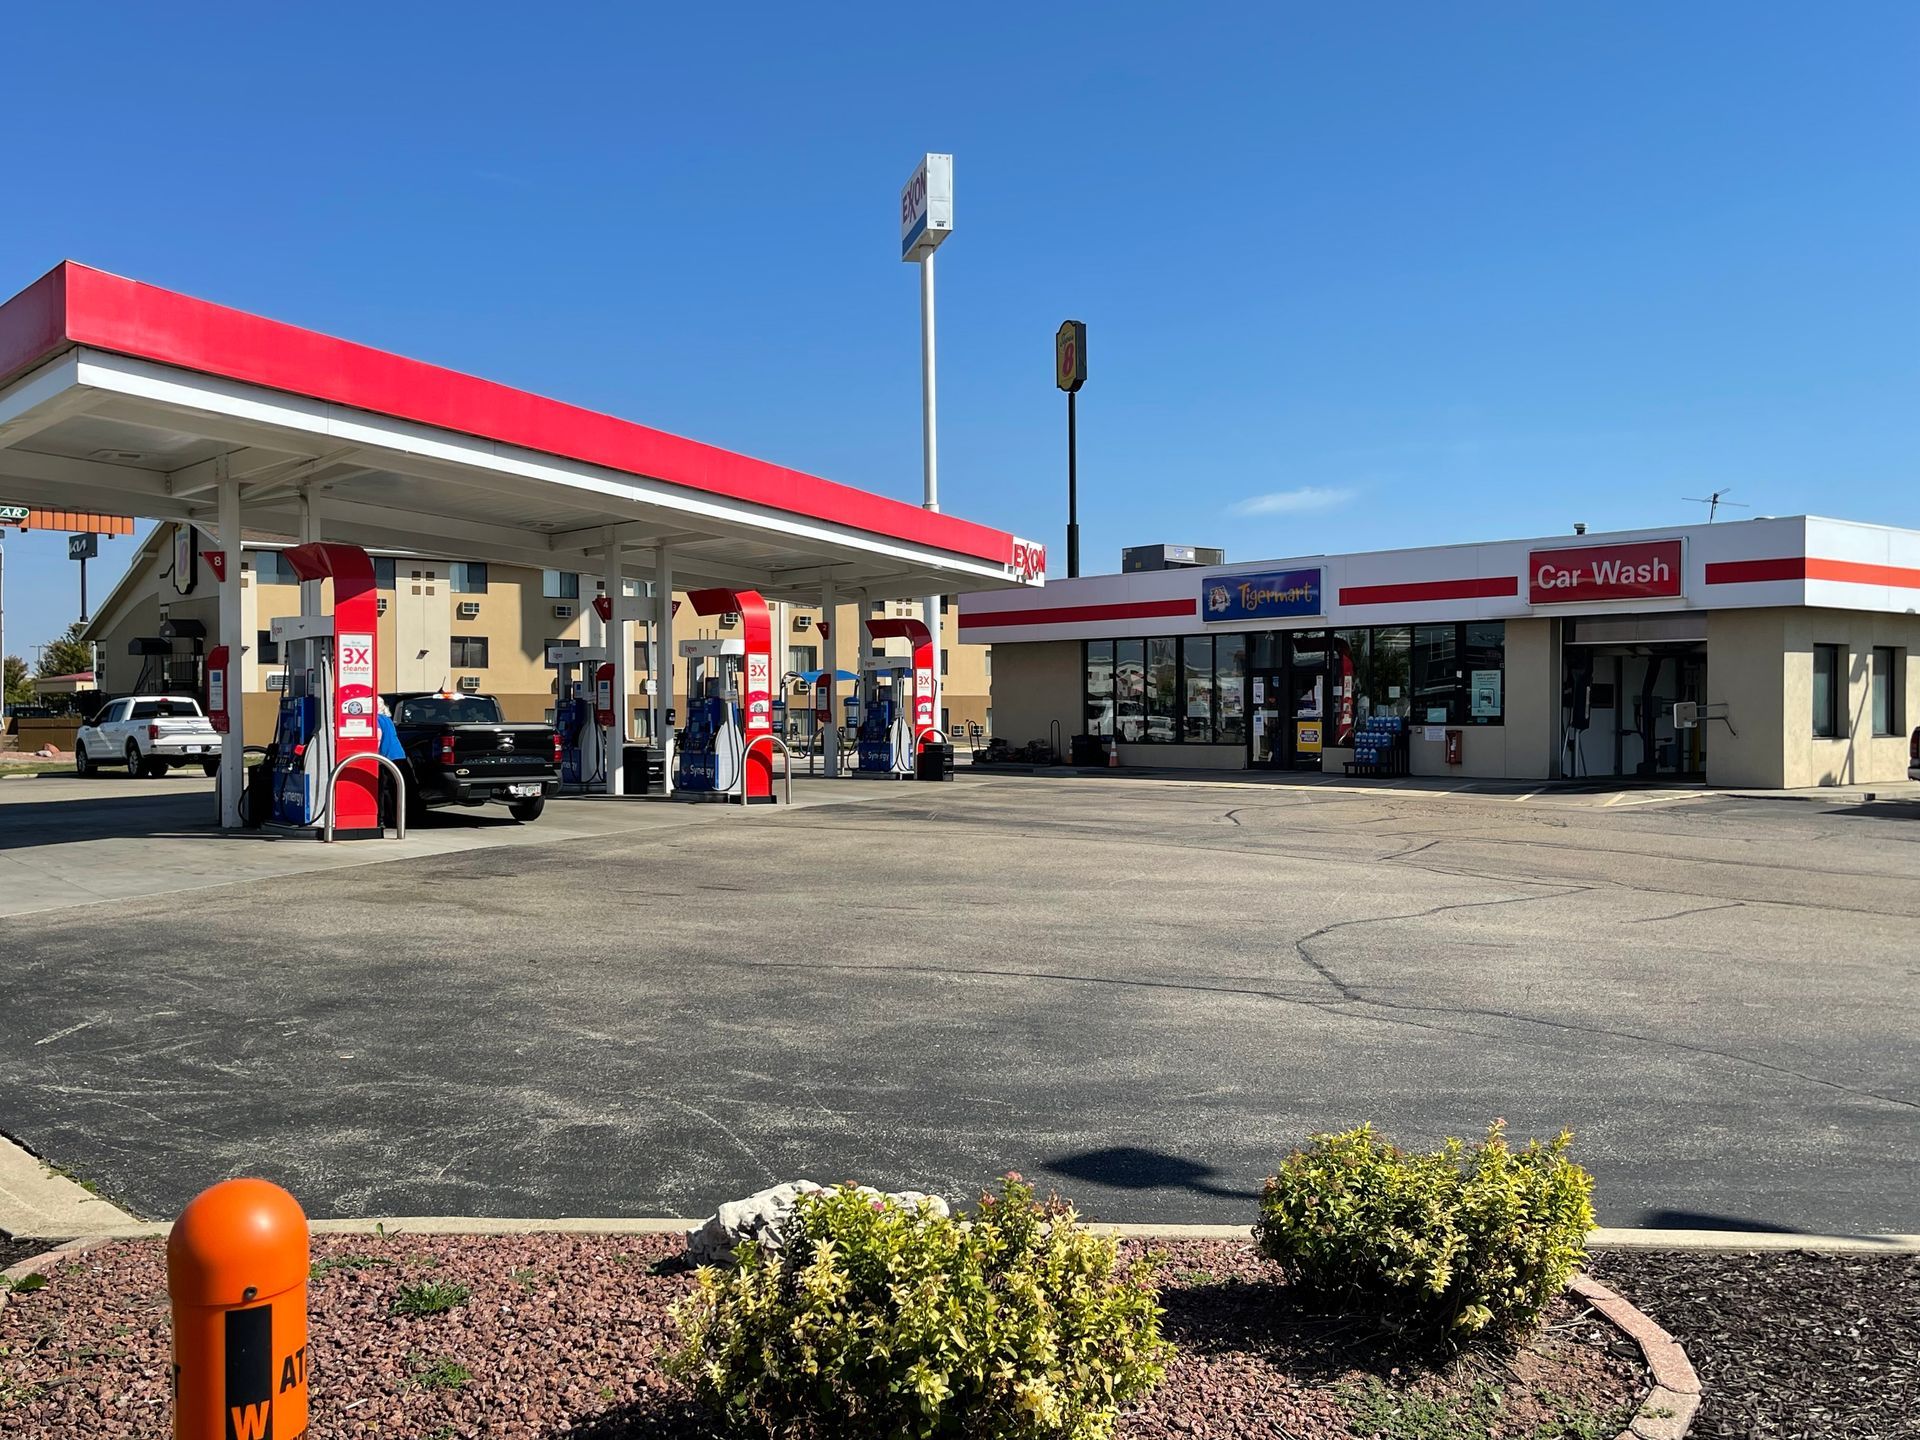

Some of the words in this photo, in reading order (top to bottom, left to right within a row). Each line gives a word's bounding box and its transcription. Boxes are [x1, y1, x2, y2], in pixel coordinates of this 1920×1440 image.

[903, 167, 926, 224] EXXON
[1062, 342, 1074, 377] 8
[0, 507, 22, 518] AR
[214, 556, 222, 567] 8
[1014, 543, 1046, 580] EXXON
[1537, 564, 1582, 589] Car
[1592, 557, 1669, 585] Wash
[1237, 582, 1313, 611] Tigermart
[343, 648, 369, 664] 3X
[343, 664, 369, 672] cleaner
[750, 664, 766, 676] 3X
[918, 676, 930, 685] 3X
[690, 764, 714, 778] Synegy
